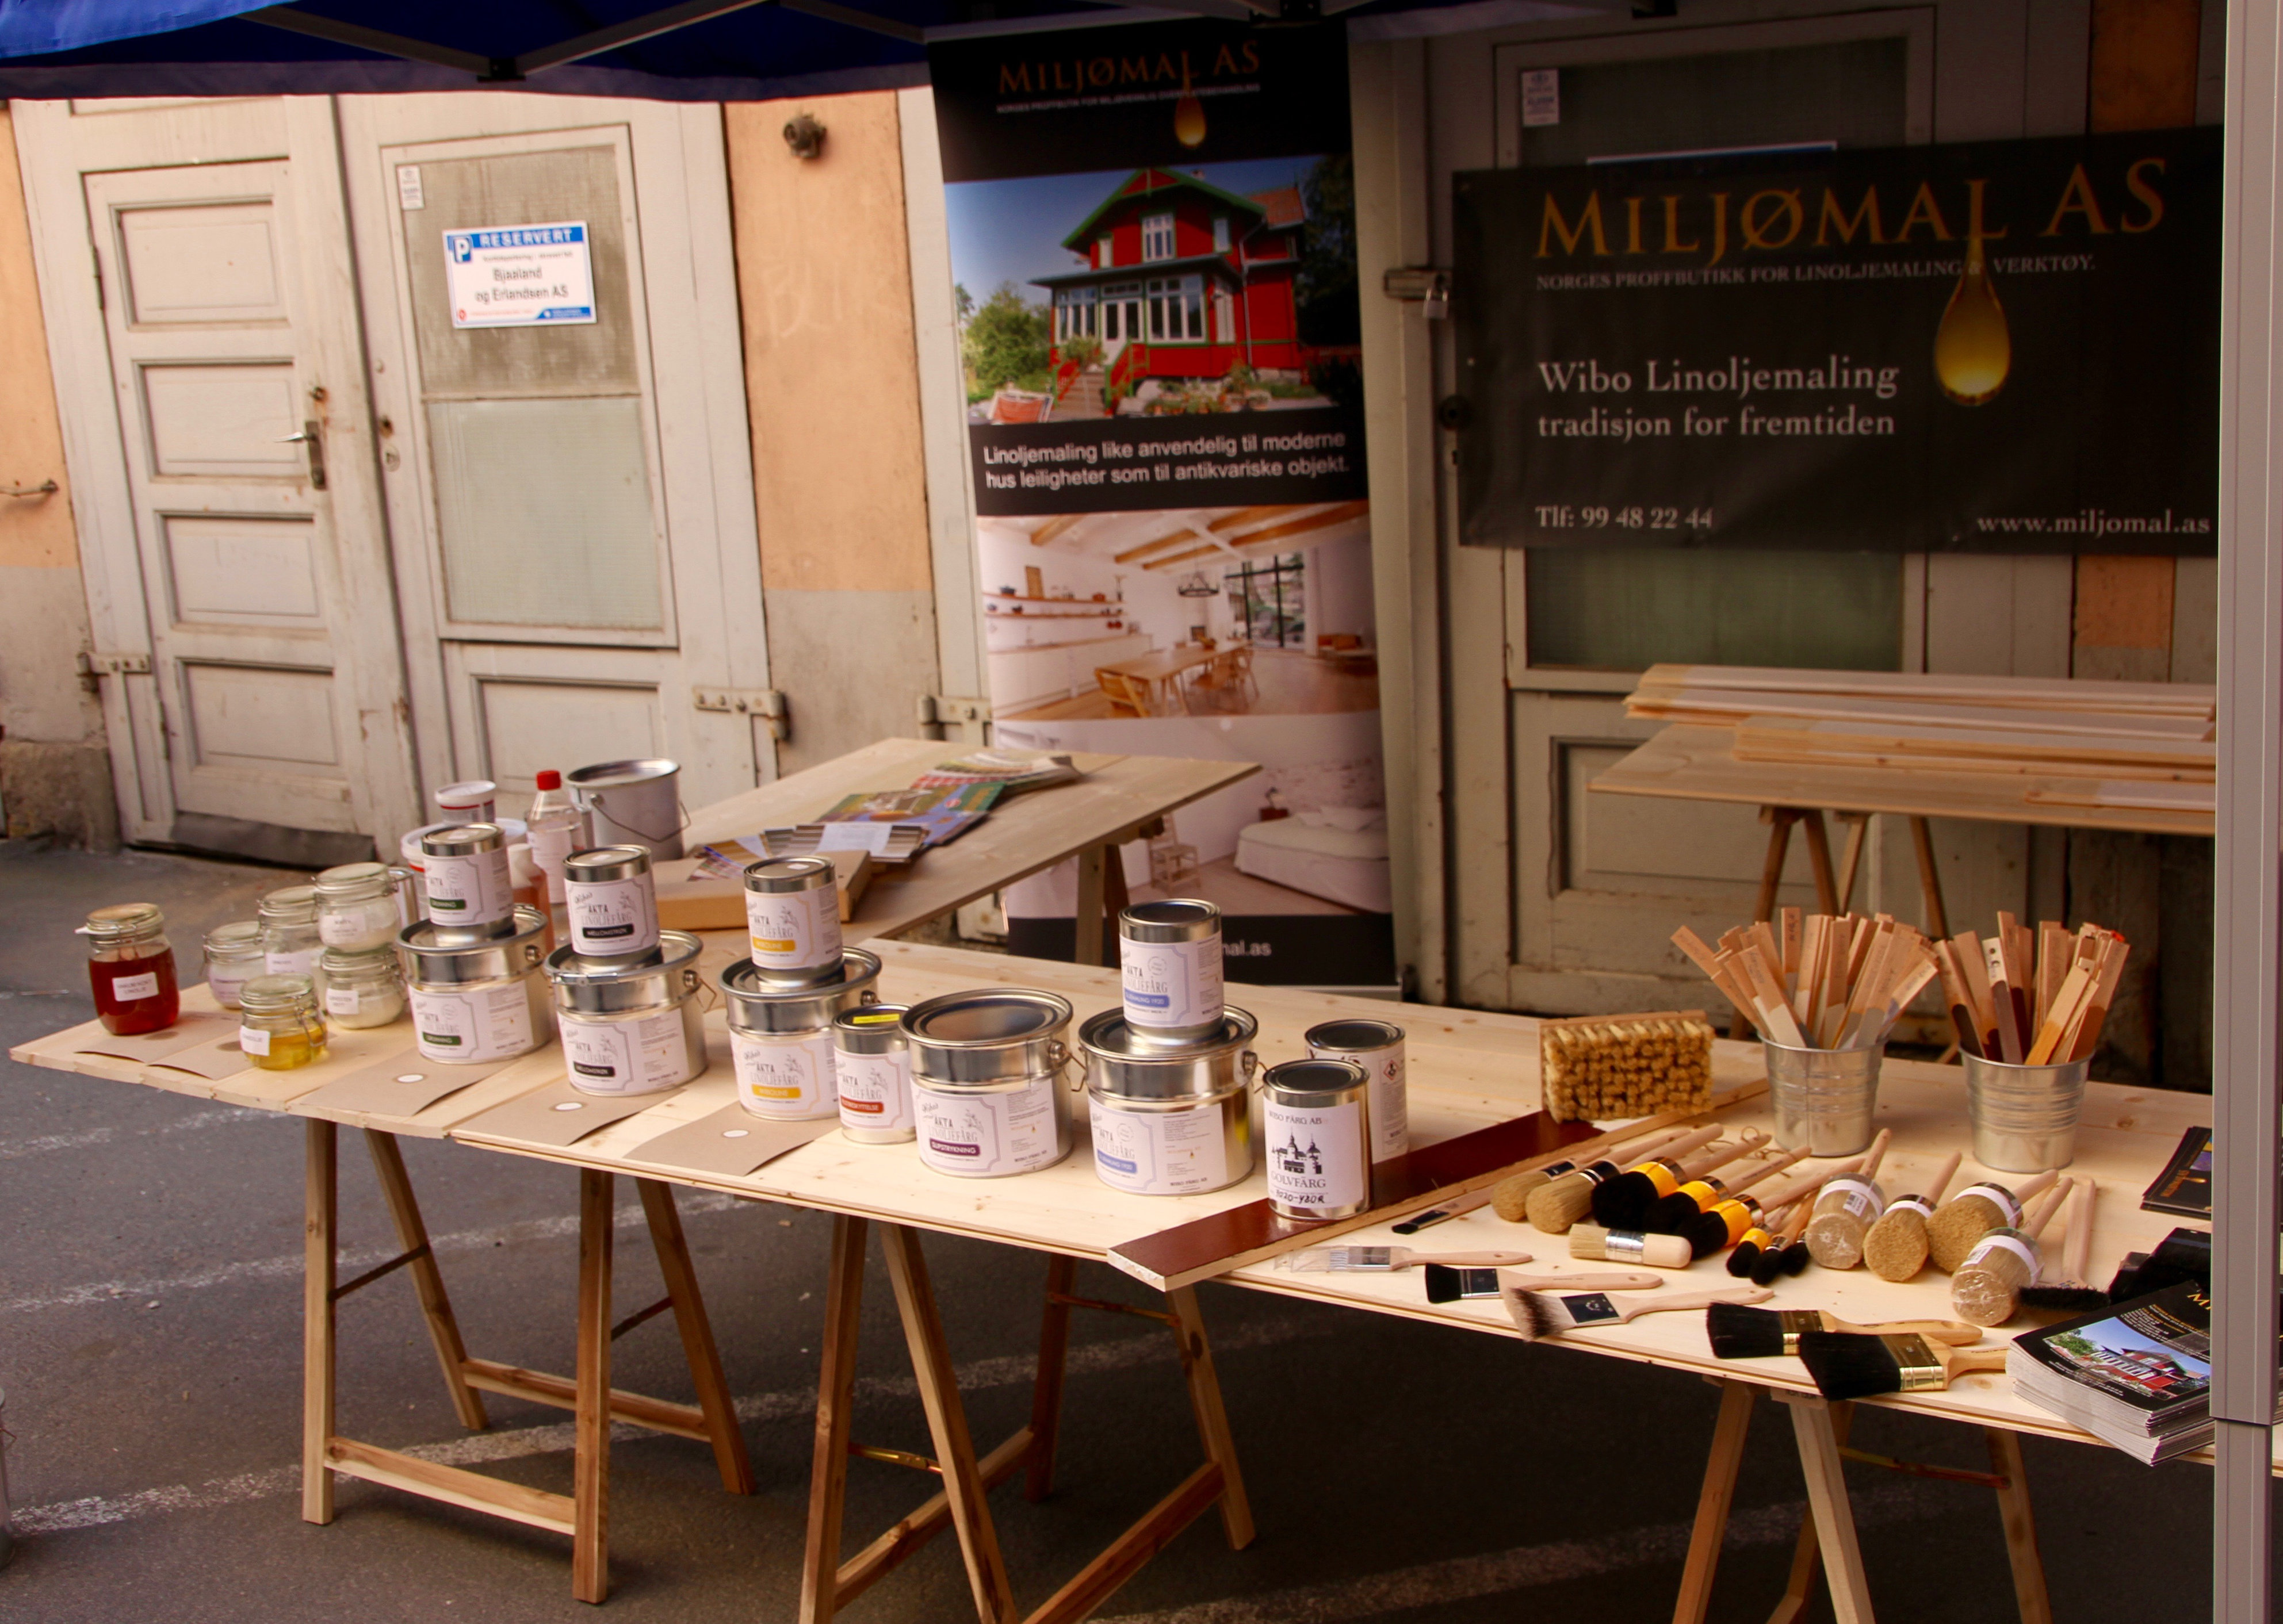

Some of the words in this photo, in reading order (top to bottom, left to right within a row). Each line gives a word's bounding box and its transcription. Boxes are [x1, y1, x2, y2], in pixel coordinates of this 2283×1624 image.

[999, 48, 1200, 94] MILJØMAL
[1211, 38, 1260, 77] AS
[1535, 179, 2007, 268] MILJØMAL
[2037, 157, 2166, 237] AS
[479, 229, 573, 247] RESERVERT
[492, 266, 542, 284] Bjaaland
[1536, 271, 1611, 290] NORGES
[1615, 267, 1745, 288] PROFFBUTIKK
[1750, 265, 1790, 282] FOR
[1795, 260, 1963, 281] LINOLJEMALING
[1993, 253, 2095, 274] VERKTØY.
[475, 292, 490, 305] og
[553, 285, 569, 298] AS
[1538, 359, 1632, 393] Wibo
[1646, 354, 1900, 400] Linoljemaling
[1538, 406, 1672, 445] tradisjon
[1684, 405, 1729, 436] for
[1739, 404, 1896, 436] fremtiden
[983, 443, 1098, 467] Linoljemaling
[1102, 440, 1134, 458] like
[1138, 435, 1237, 457] anvendelig
[1242, 434, 1257, 453] til
[1262, 432, 1345, 450] moderne
[985, 470, 1016, 488] hus
[1020, 468, 1107, 491] leiligheter
[1111, 466, 1149, 484] som
[1154, 464, 1169, 481] til
[1175, 459, 1283, 481] antikvariske
[1287, 456, 1349, 478] objekt.
[1535, 504, 1575, 528] Tlf:
[1581, 505, 1609, 528] 99
[1615, 505, 1644, 528] 48
[1650, 505, 1678, 529] 22
[1685, 506, 1714, 530] 44
[1977, 508, 2209, 539] www.miljomal.as
[1309, 1117, 1322, 1125] AB
